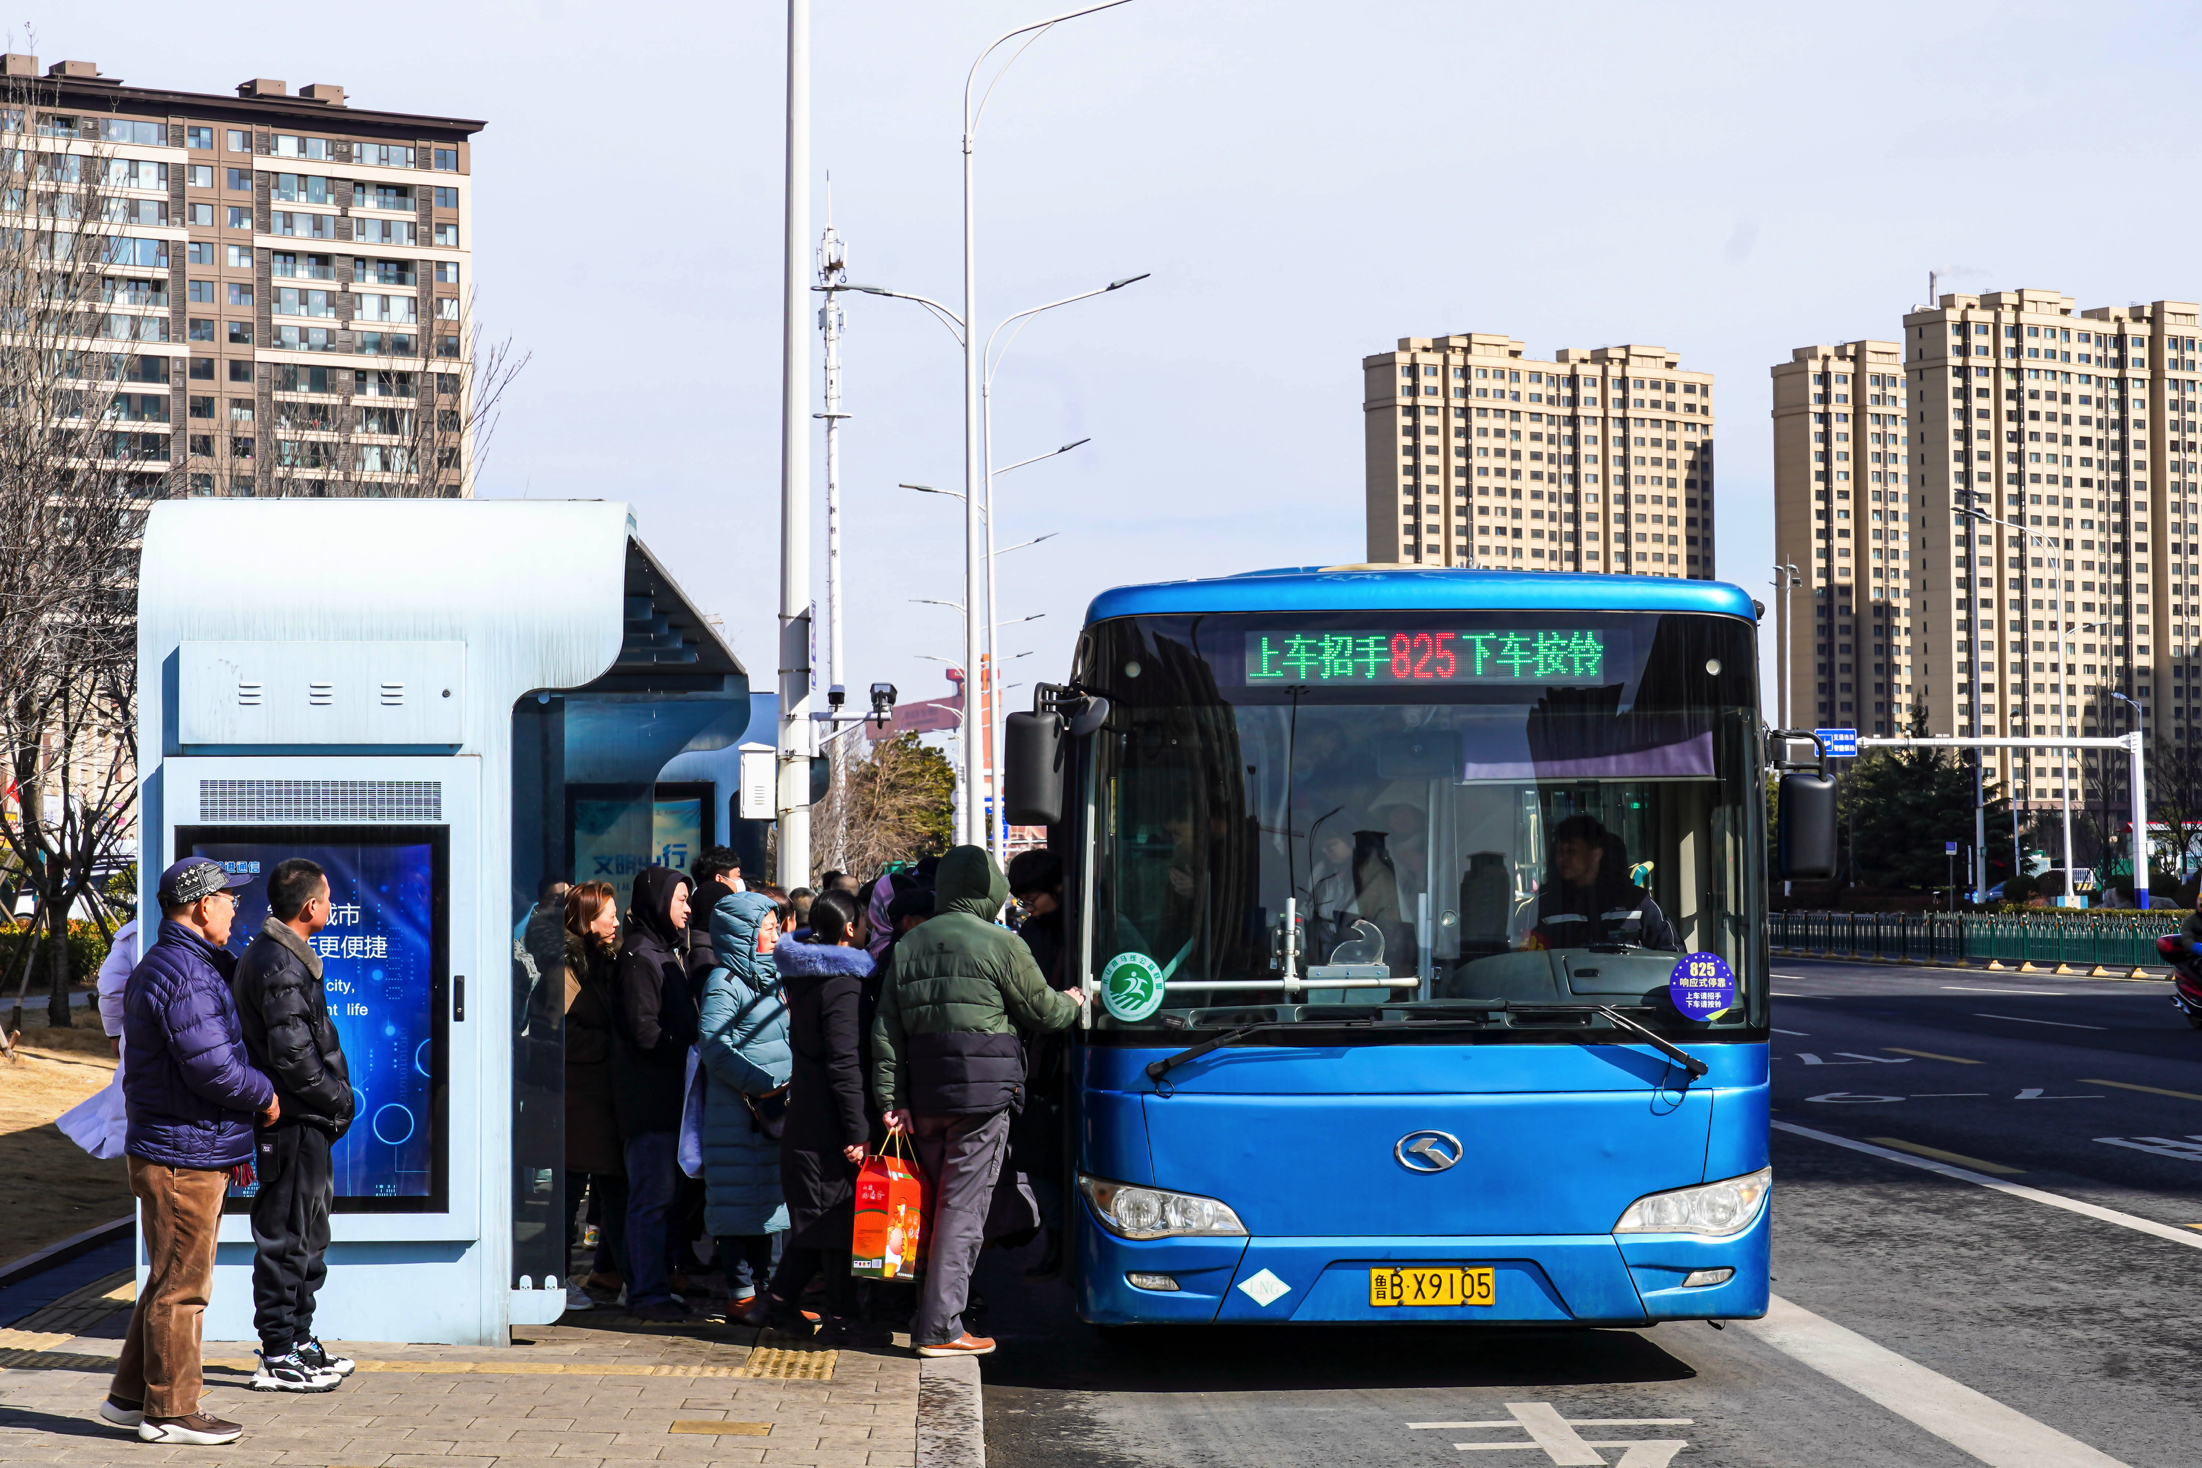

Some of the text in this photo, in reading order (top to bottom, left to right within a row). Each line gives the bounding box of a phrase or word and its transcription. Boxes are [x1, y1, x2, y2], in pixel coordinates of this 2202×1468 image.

[1690, 962, 1715, 976] 825
[326, 979, 355, 995] city,
[1679, 978, 1726, 988] 响应式停靠
[1685, 992, 1722, 1000] 上车请招手
[347, 1003, 369, 1016] life
[1685, 1000, 1722, 1008] 下车请按铃
[1249, 1280, 1280, 1295] LNG
